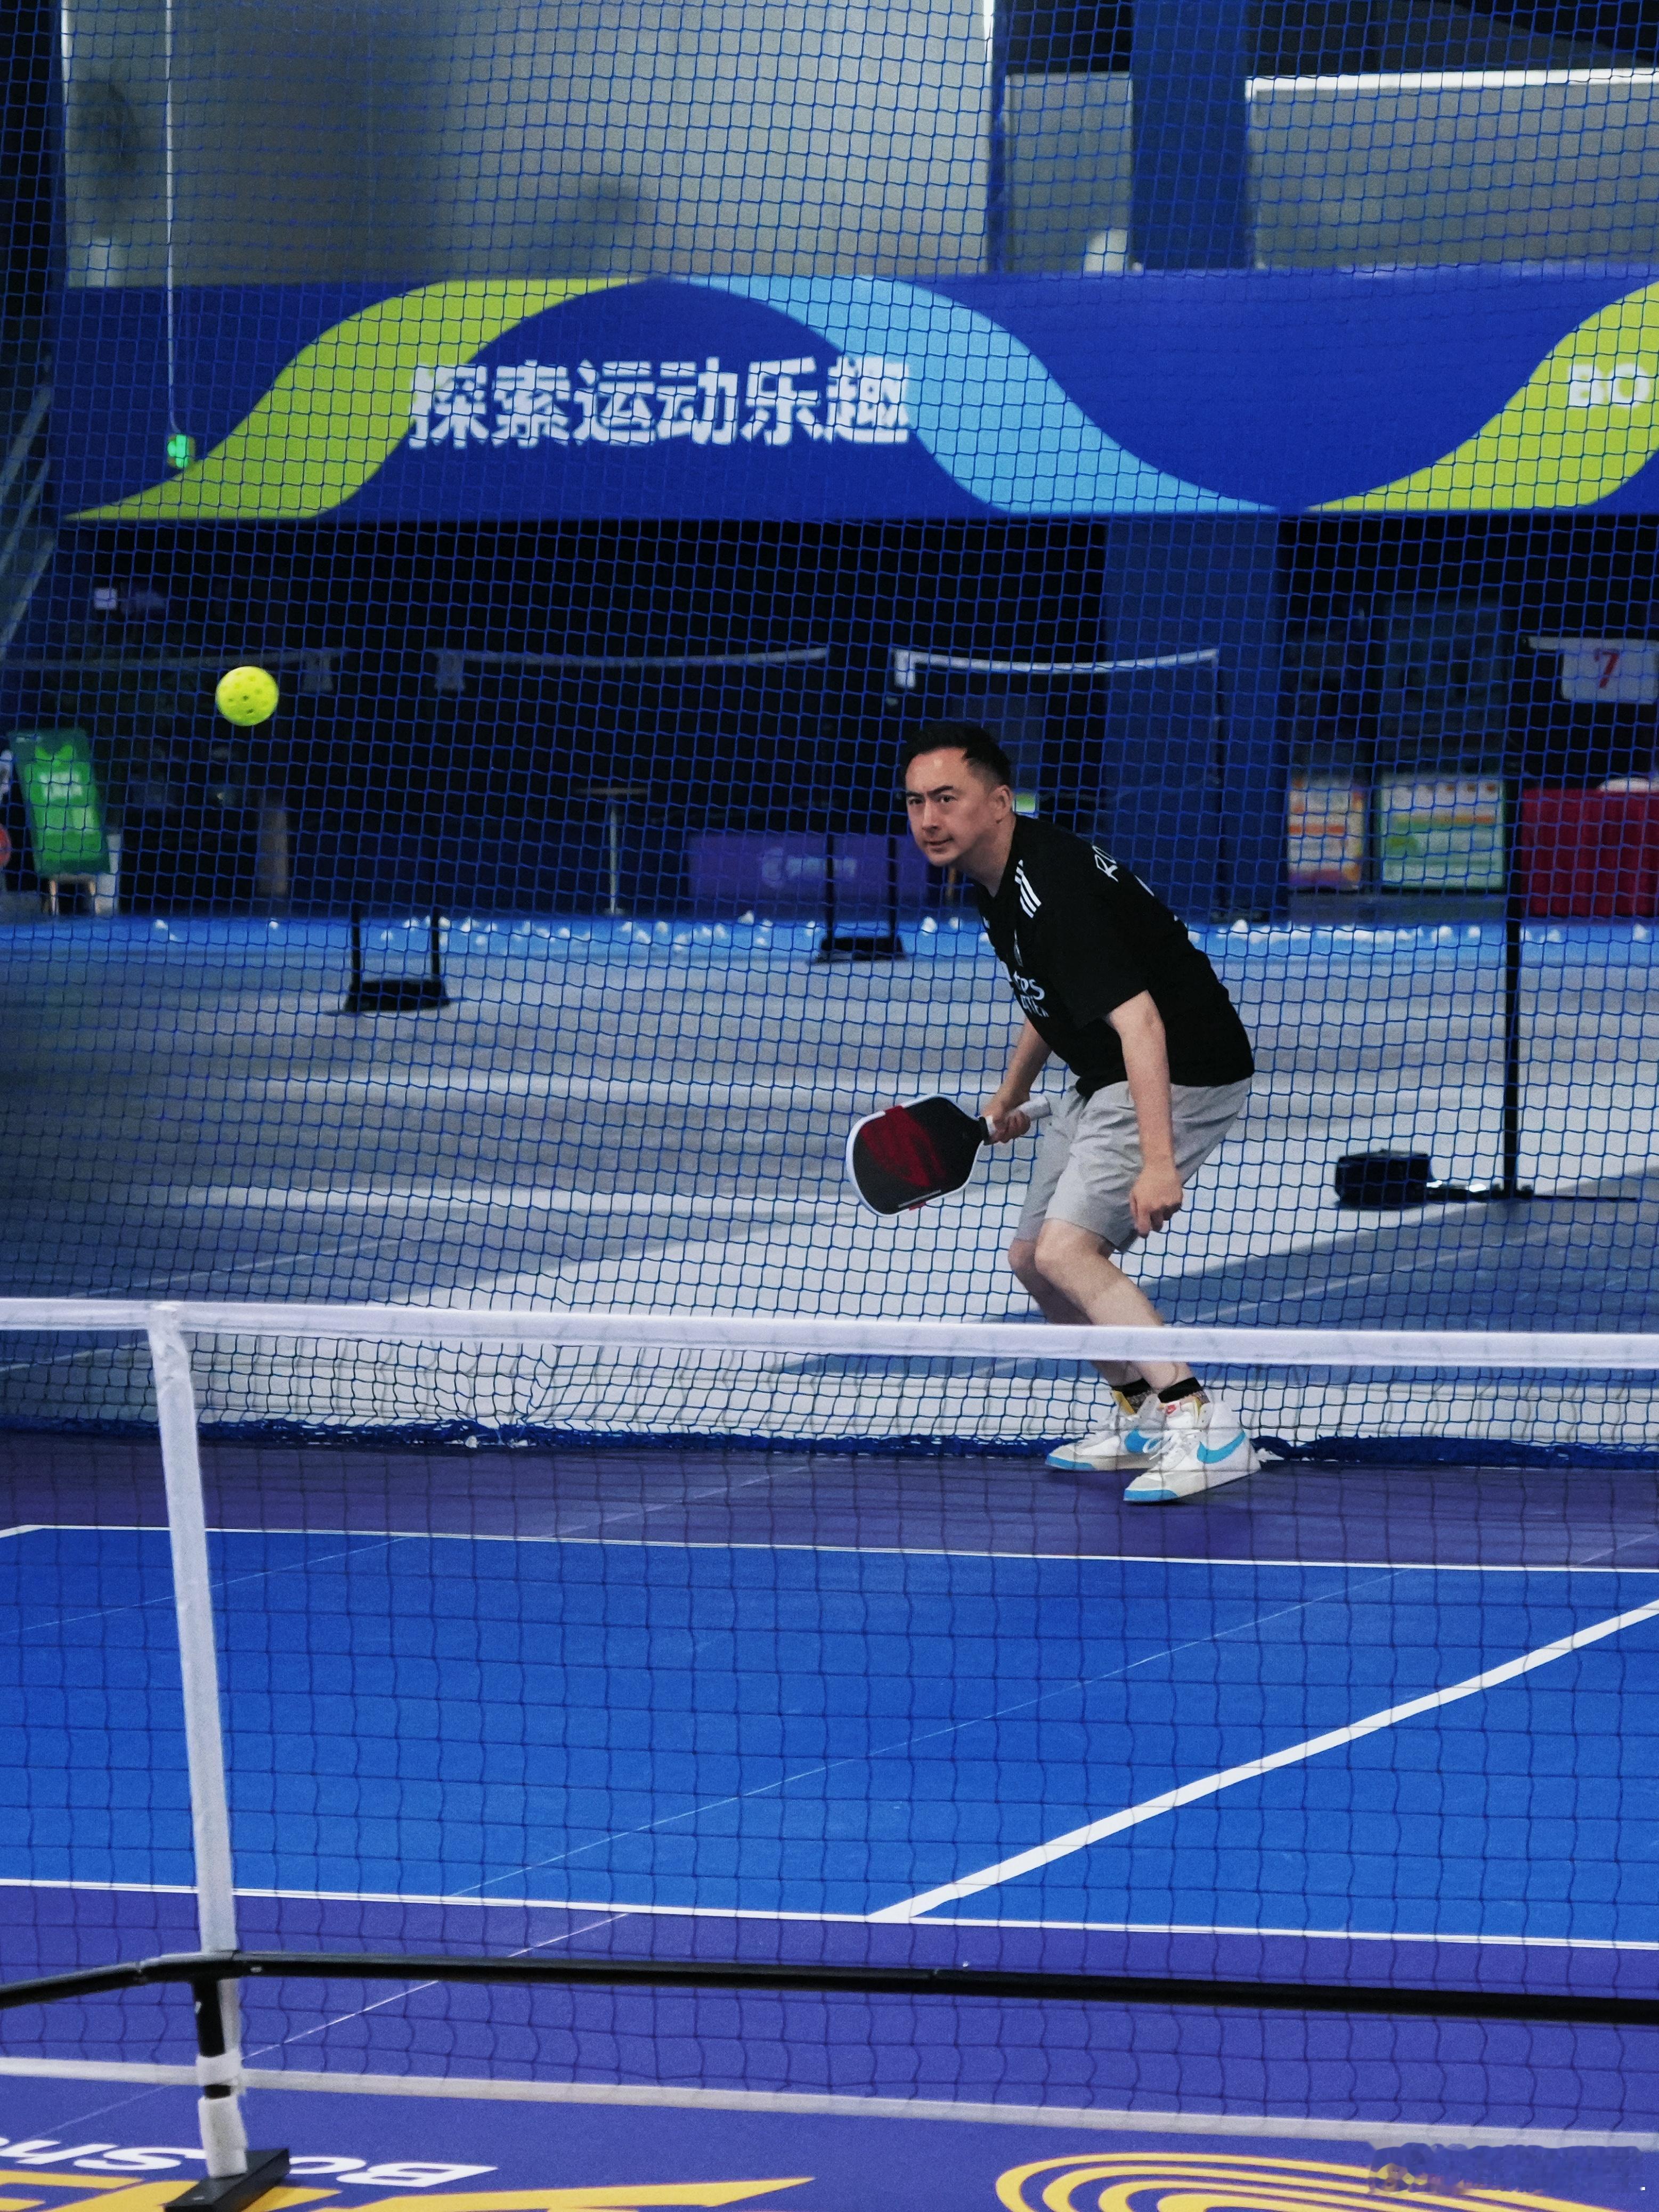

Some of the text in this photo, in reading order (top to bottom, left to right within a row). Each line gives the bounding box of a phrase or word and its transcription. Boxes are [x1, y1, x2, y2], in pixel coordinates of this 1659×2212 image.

[408, 357, 909, 448] 探索运动乐趣
[1593, 648, 1620, 688] 7
